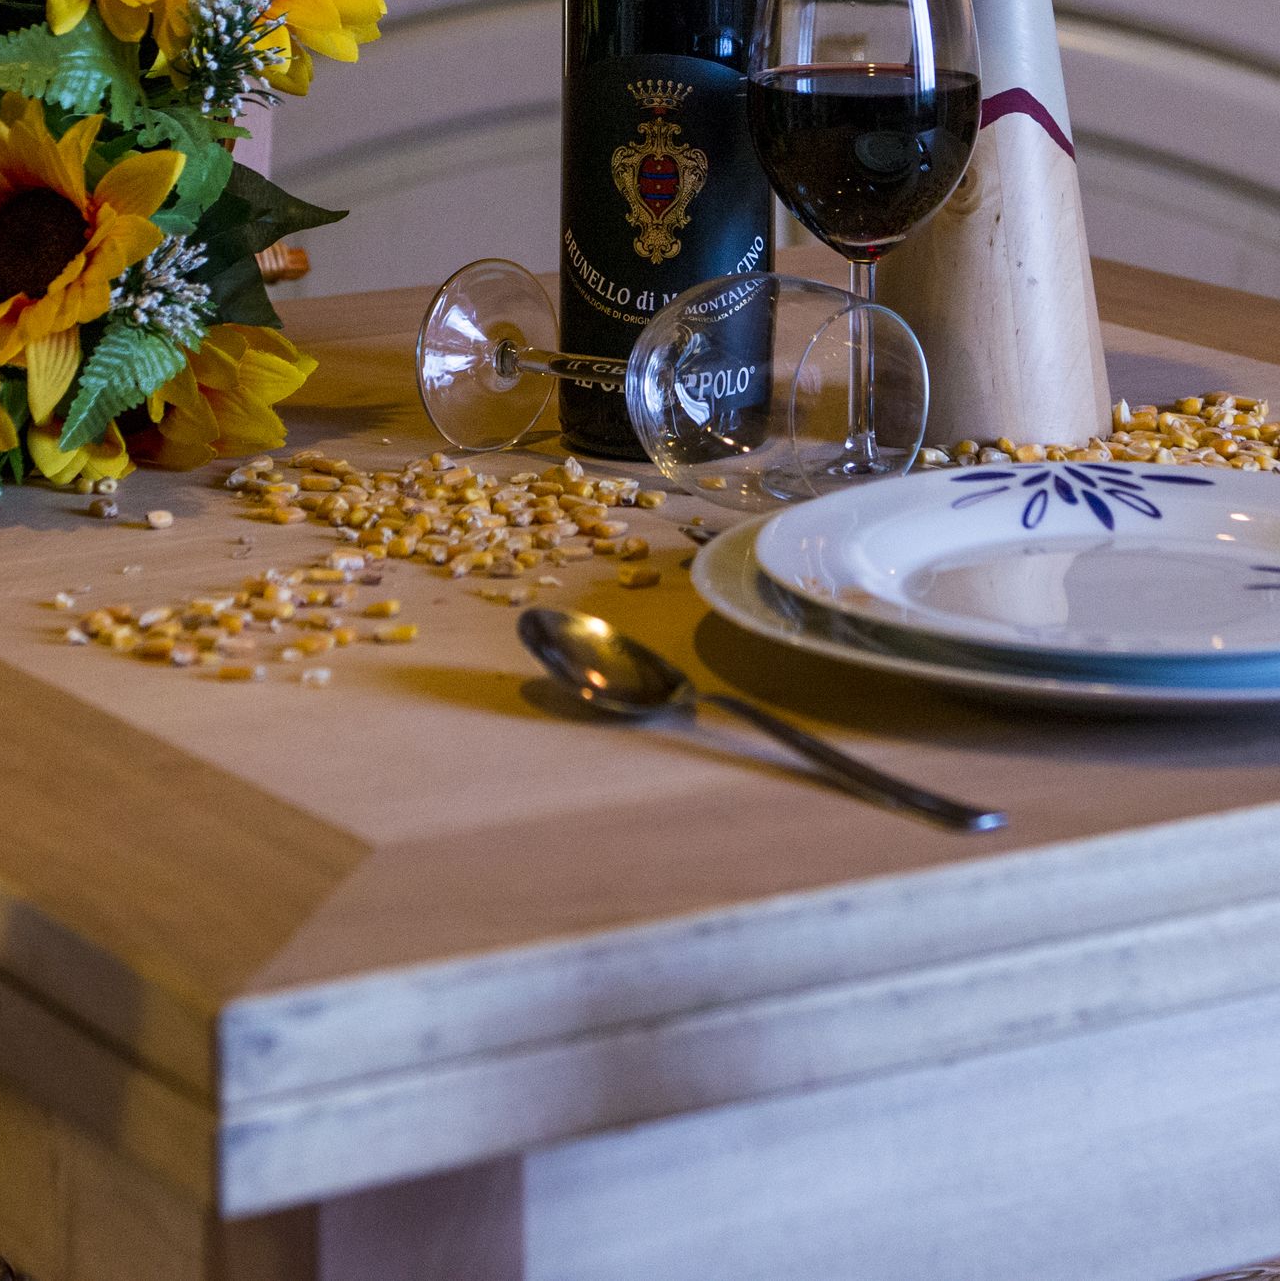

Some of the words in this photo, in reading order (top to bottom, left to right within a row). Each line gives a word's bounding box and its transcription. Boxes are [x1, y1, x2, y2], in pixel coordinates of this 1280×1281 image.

[564, 226, 631, 305] BRUNELLO
[636, 290, 655, 311] di
[622, 313, 650, 325] ORIGI
